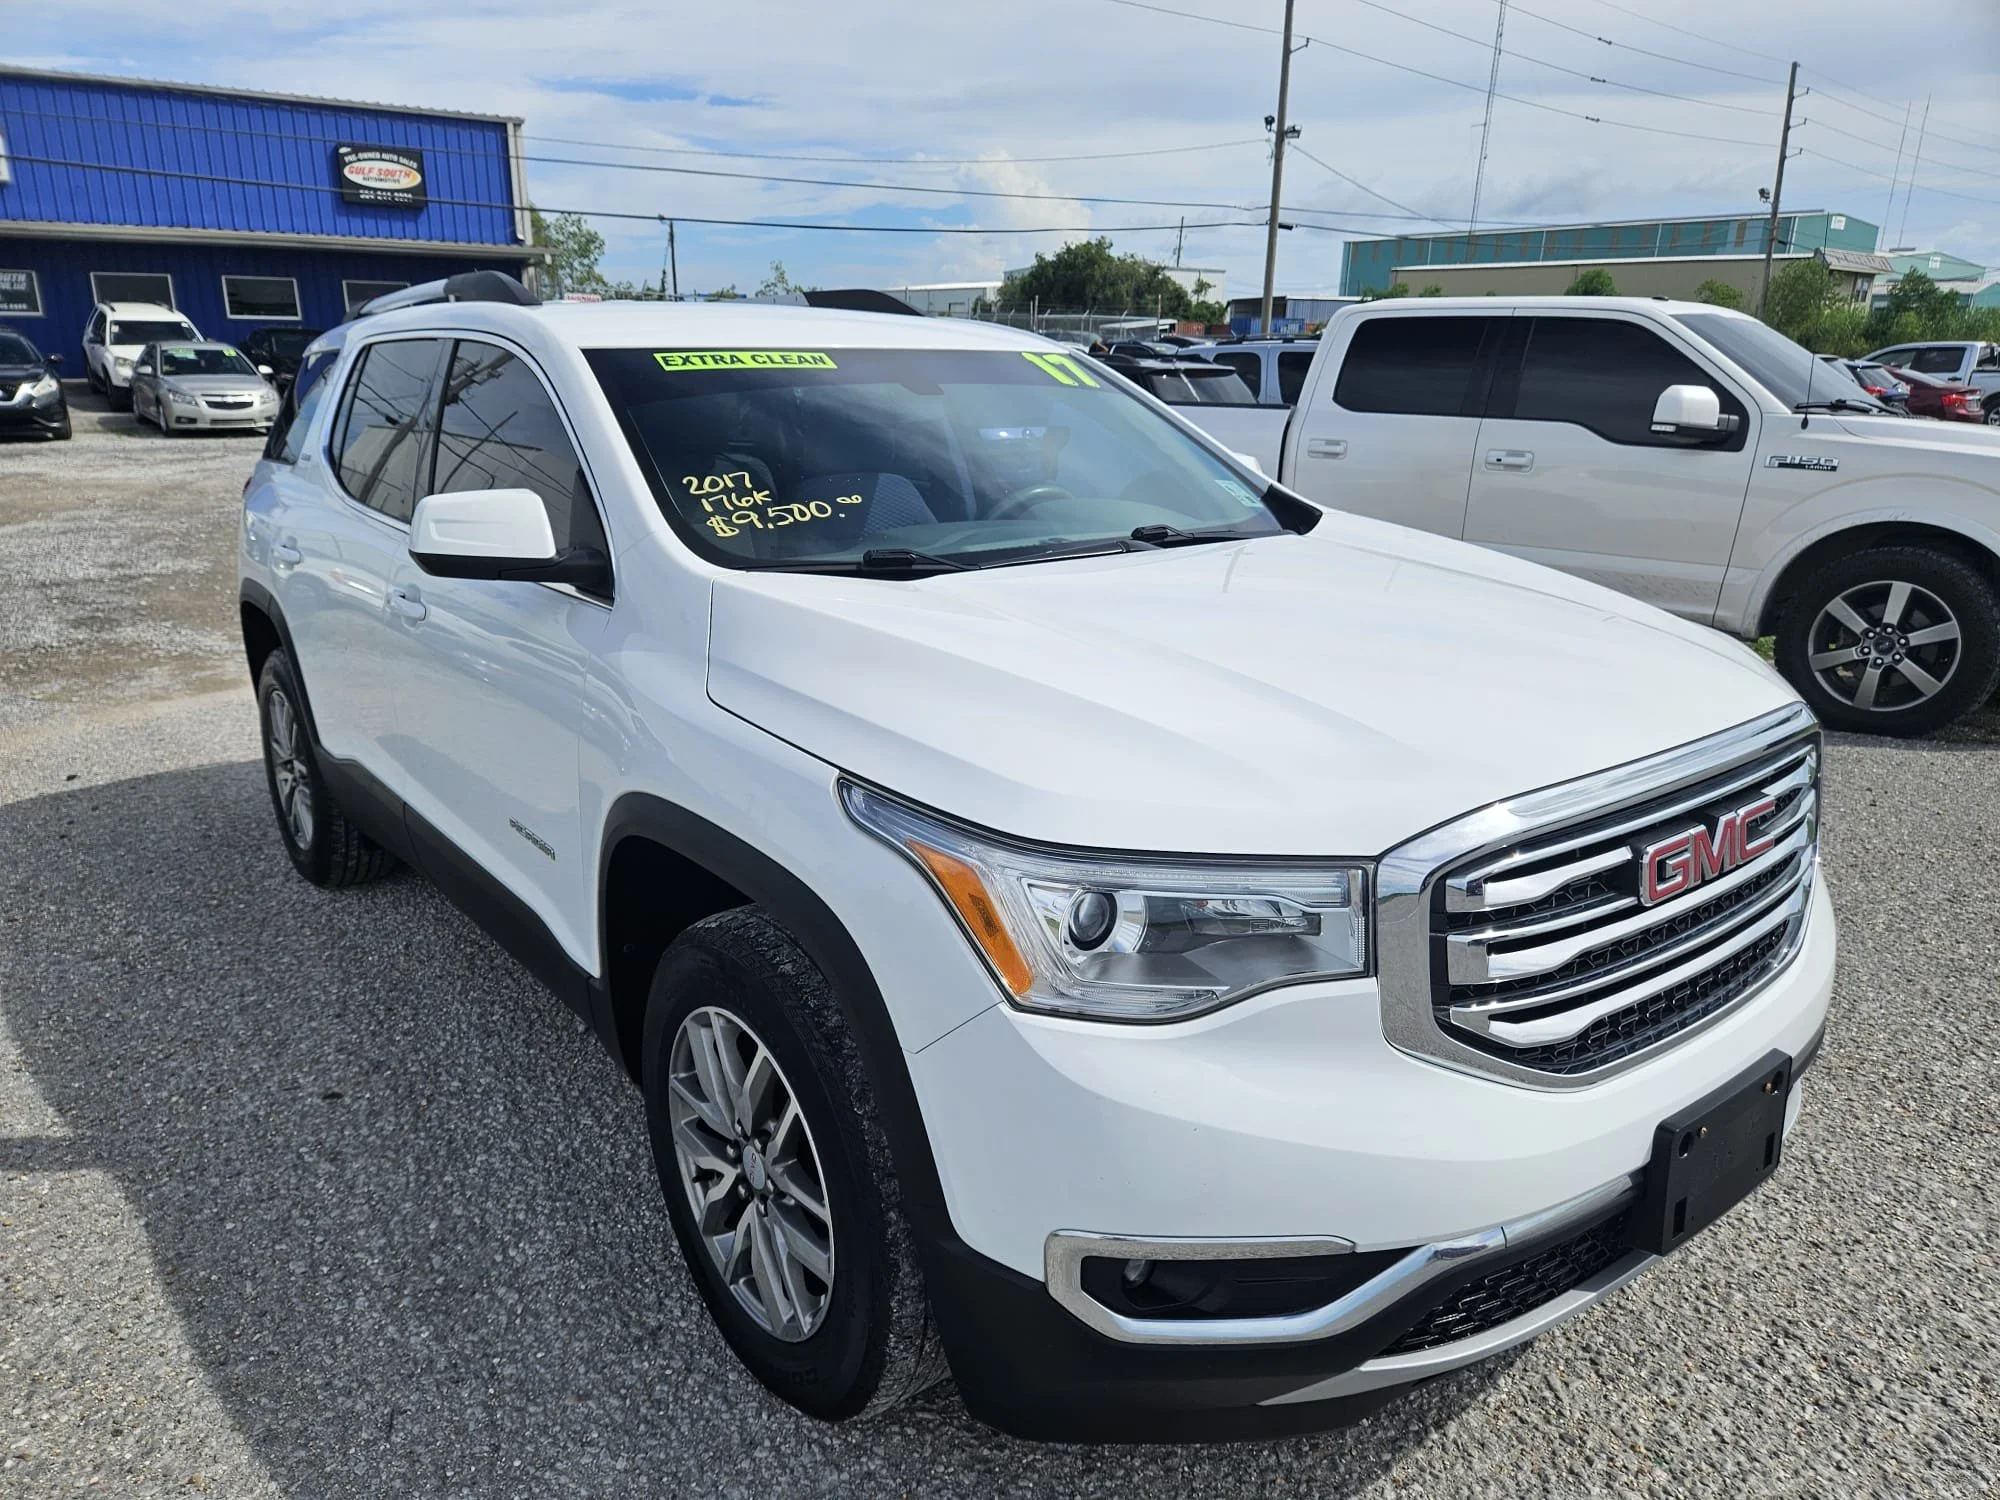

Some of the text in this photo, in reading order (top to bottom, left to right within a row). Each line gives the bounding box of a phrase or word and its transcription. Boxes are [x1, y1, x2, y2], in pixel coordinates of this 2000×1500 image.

[382, 153, 398, 161] AUTO
[399, 156, 417, 169] SALES
[348, 166, 412, 178] GULF SOUTH
[661, 354, 826, 366] EXTRA CLEAN
[1021, 351, 1101, 388] 17
[682, 471, 752, 494] 2017
[1639, 795, 1776, 906] GMC
